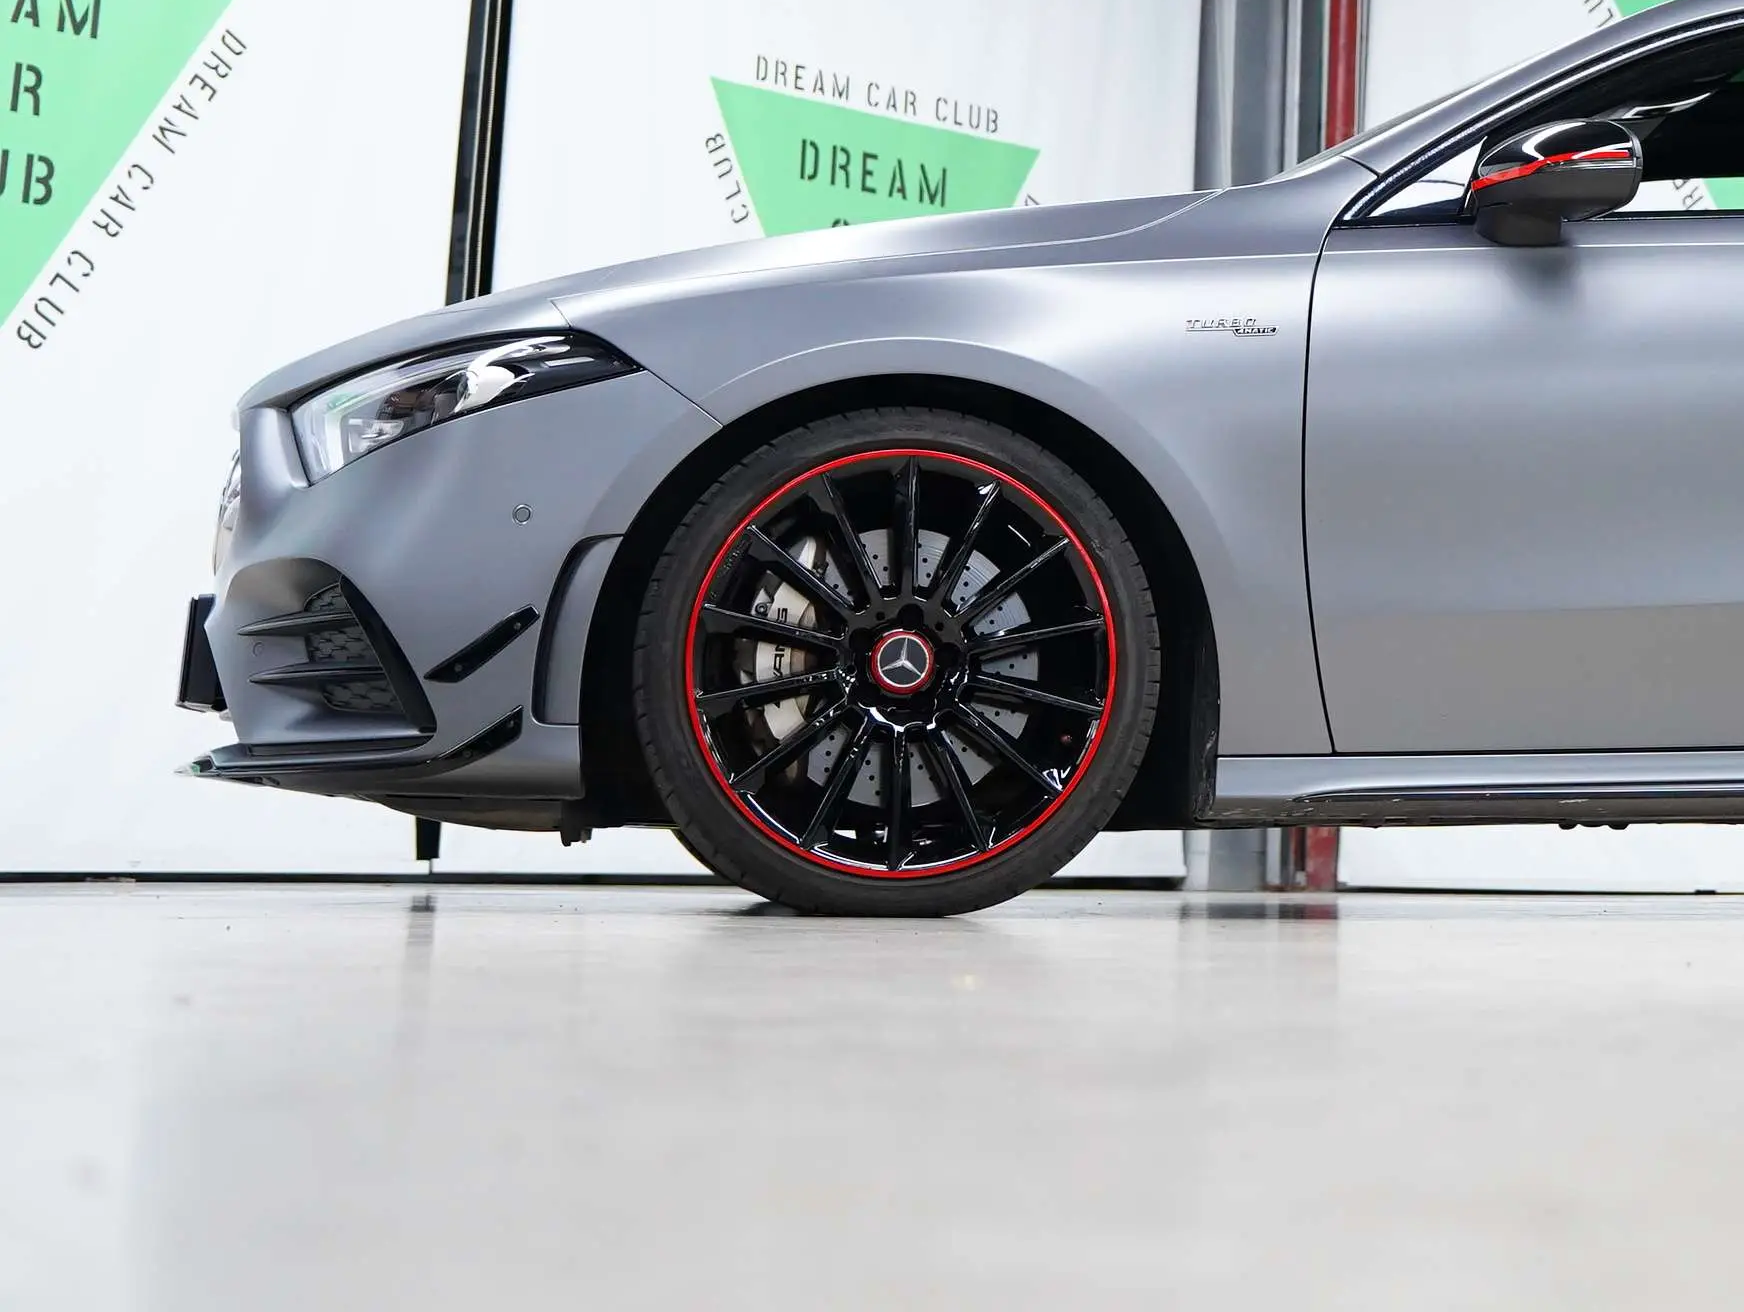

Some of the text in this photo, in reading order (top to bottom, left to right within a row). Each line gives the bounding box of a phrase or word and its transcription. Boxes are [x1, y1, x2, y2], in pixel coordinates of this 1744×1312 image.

[756, 55, 999, 134] DREAM CAR CLUB
[16, 29, 247, 350] DREAM CAR CLUB
[705, 132, 749, 224] CLUB
[800, 139, 947, 207] DREAM
[1185, 318, 1257, 329] TURBO
